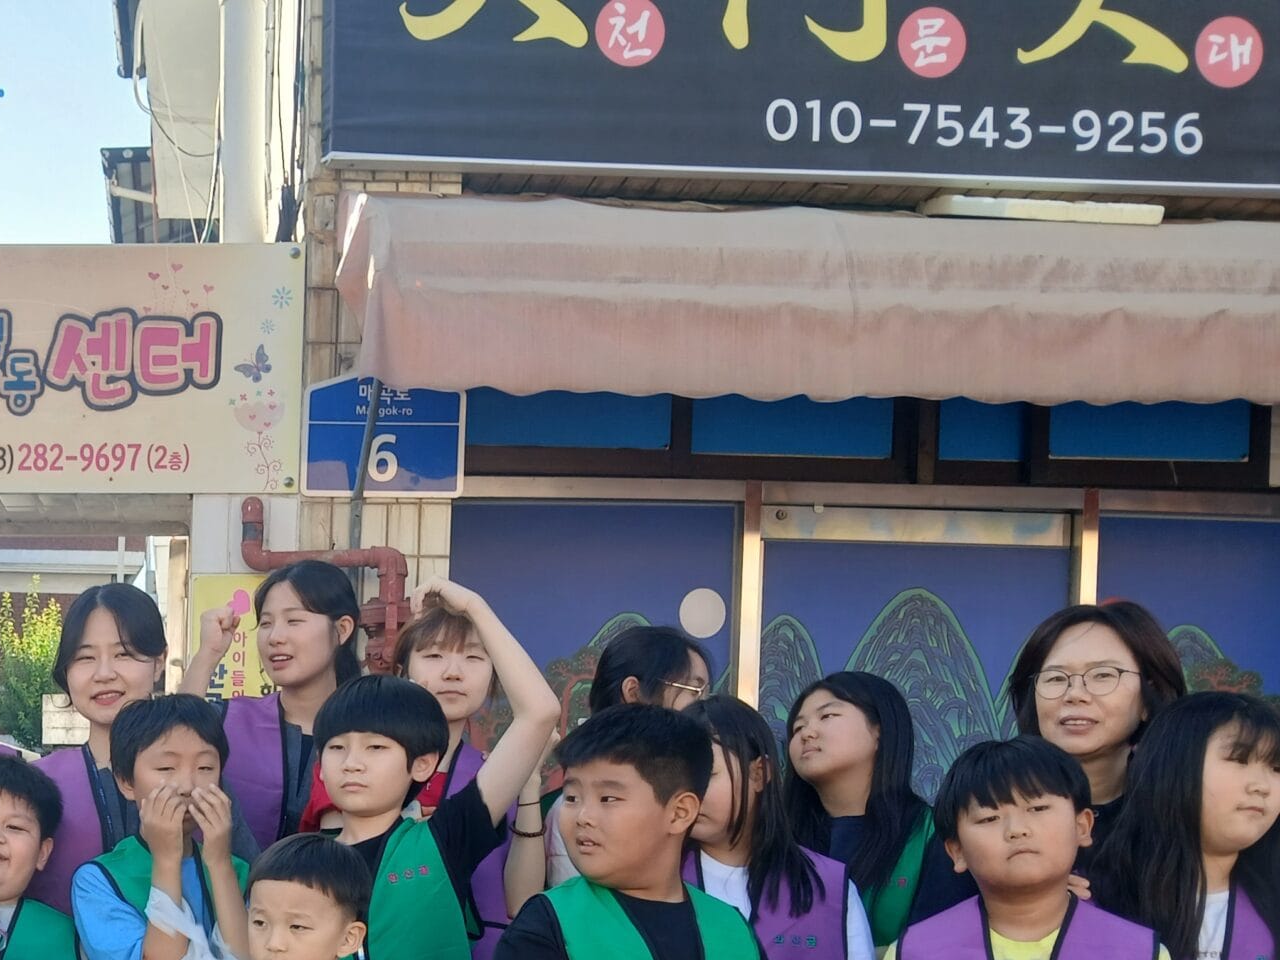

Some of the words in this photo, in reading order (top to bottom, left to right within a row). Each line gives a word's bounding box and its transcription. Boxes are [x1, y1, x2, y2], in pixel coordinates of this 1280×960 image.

[909, 17, 952, 68] 문
[1208, 33, 1254, 72] 대
[765, 98, 1204, 155] 010-7543-9256
[49, 313, 216, 403] 센터
[367, 433, 398, 482] 6
